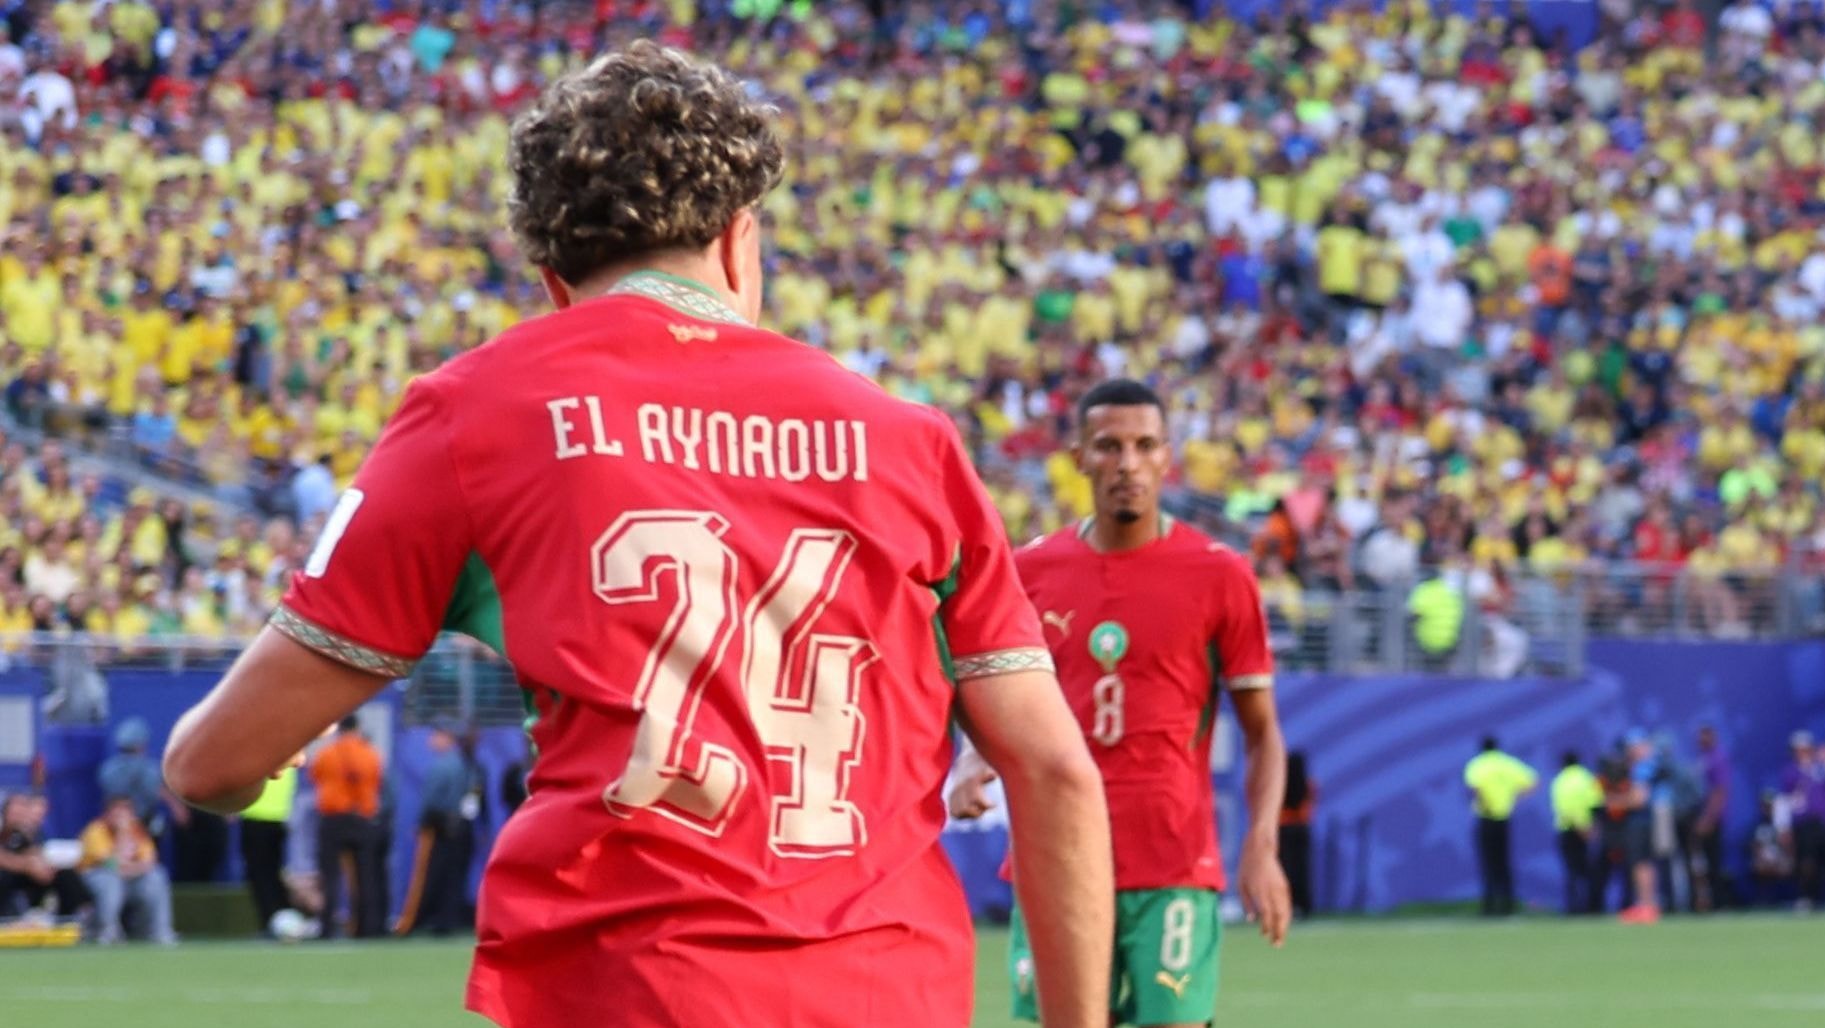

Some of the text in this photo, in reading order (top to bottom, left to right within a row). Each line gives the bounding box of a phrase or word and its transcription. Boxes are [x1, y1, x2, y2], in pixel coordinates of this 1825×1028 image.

[546, 395, 869, 482] EL AYNAOUI
[590, 509, 882, 860] 24
[1093, 672, 1125, 746] 8
[1160, 898, 1196, 971] 8
